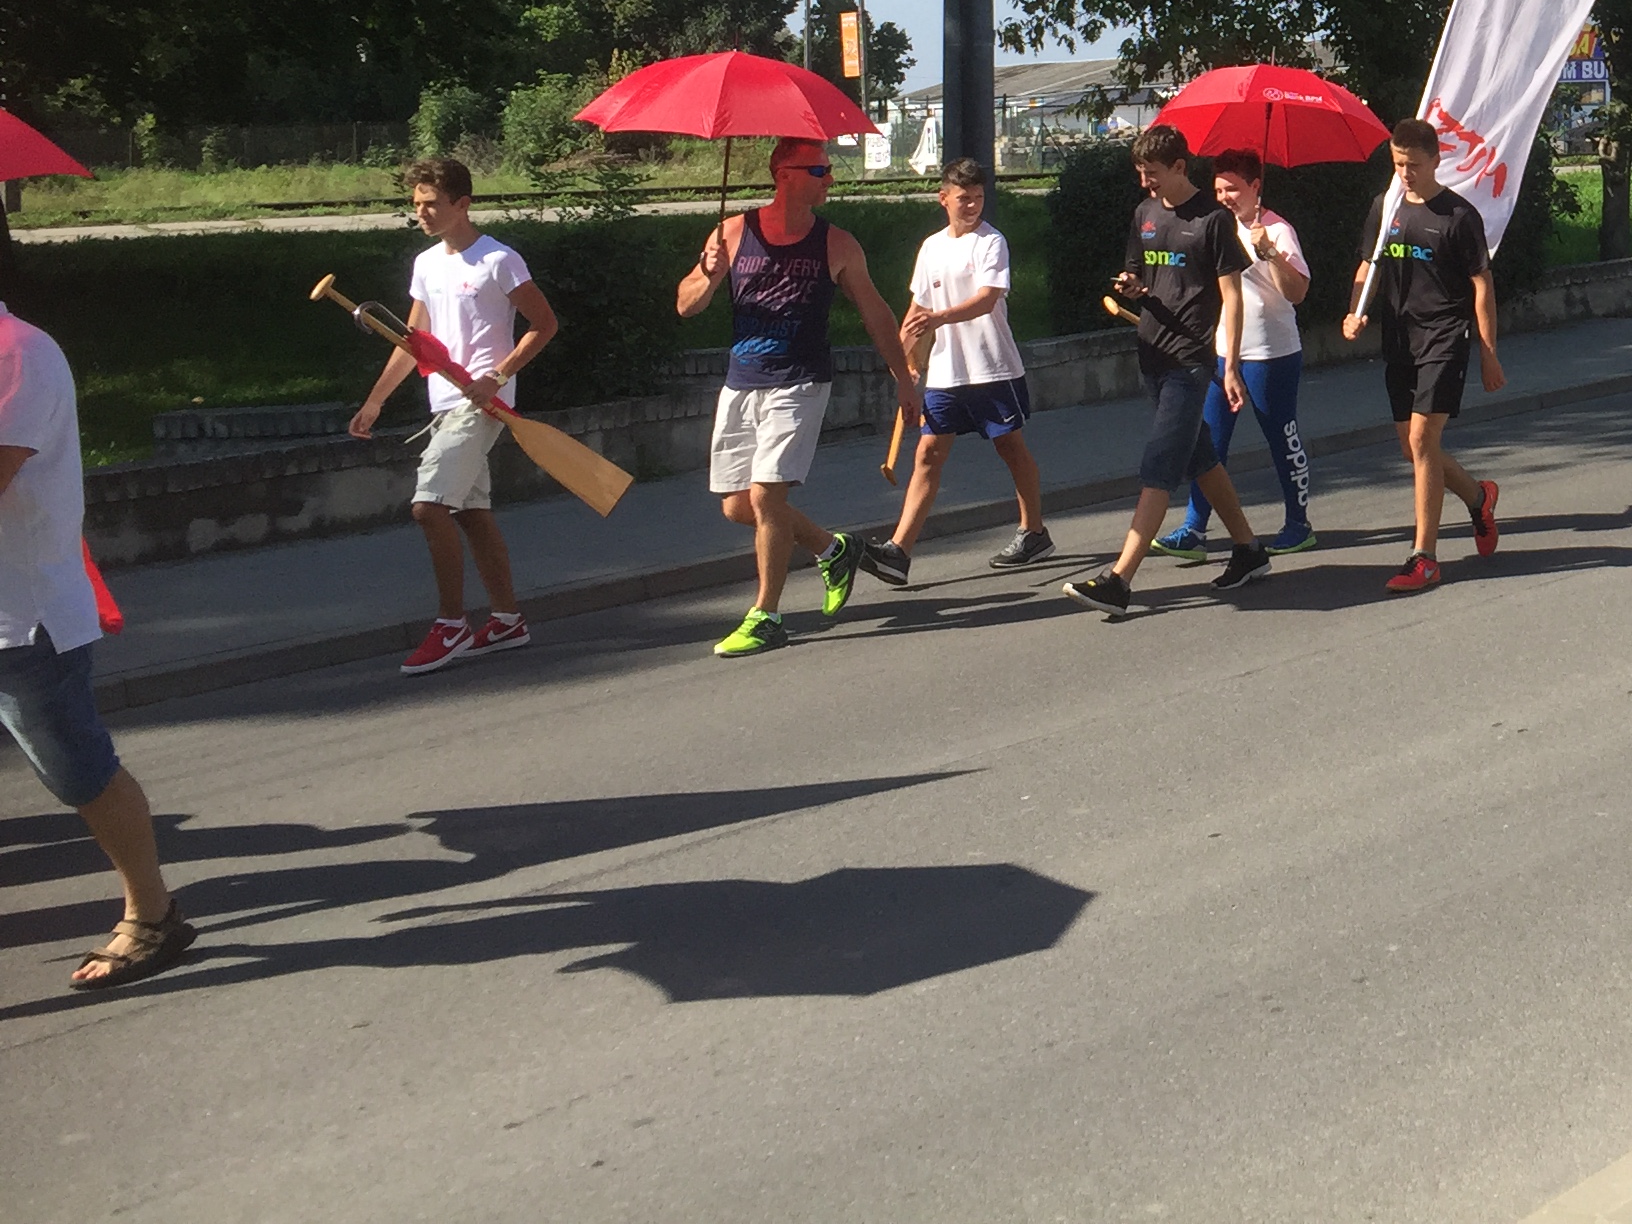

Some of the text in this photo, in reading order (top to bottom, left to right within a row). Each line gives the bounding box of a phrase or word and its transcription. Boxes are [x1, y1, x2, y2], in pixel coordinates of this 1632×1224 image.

[736, 256, 771, 274] RIDE
[1143, 250, 1187, 268] sonac
[1283, 419, 1310, 507] adidas
